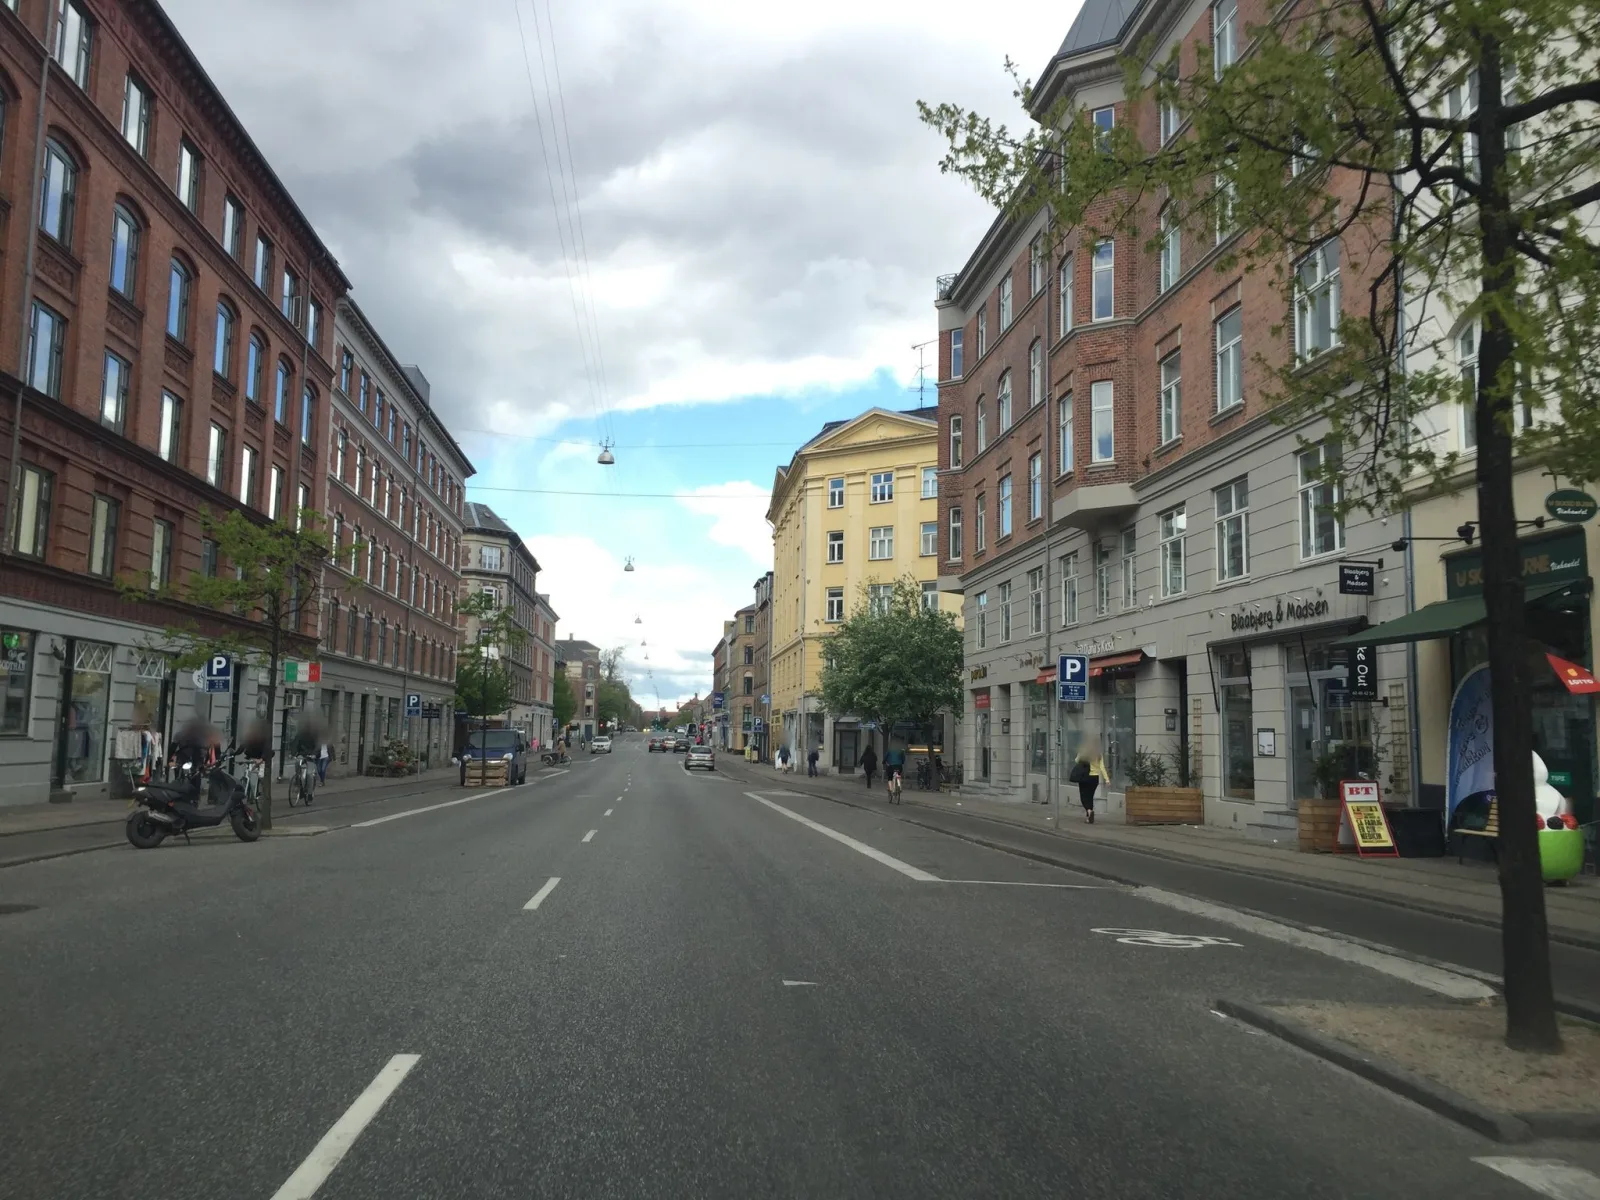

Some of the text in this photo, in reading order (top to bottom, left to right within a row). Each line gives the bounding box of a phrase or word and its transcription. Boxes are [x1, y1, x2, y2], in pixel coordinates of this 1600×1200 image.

[1344, 568, 1370, 576] Blaabjerg
[1231, 598, 1329, 632] Blaabjerg & Madsen
[212, 656, 226, 675] P
[1066, 658, 1081, 680] P
[1356, 646, 1368, 687] ke Out
[1568, 678, 1594, 686] LOTTO
[409, 695, 418, 707] P
[1348, 786, 1373, 796] BT
